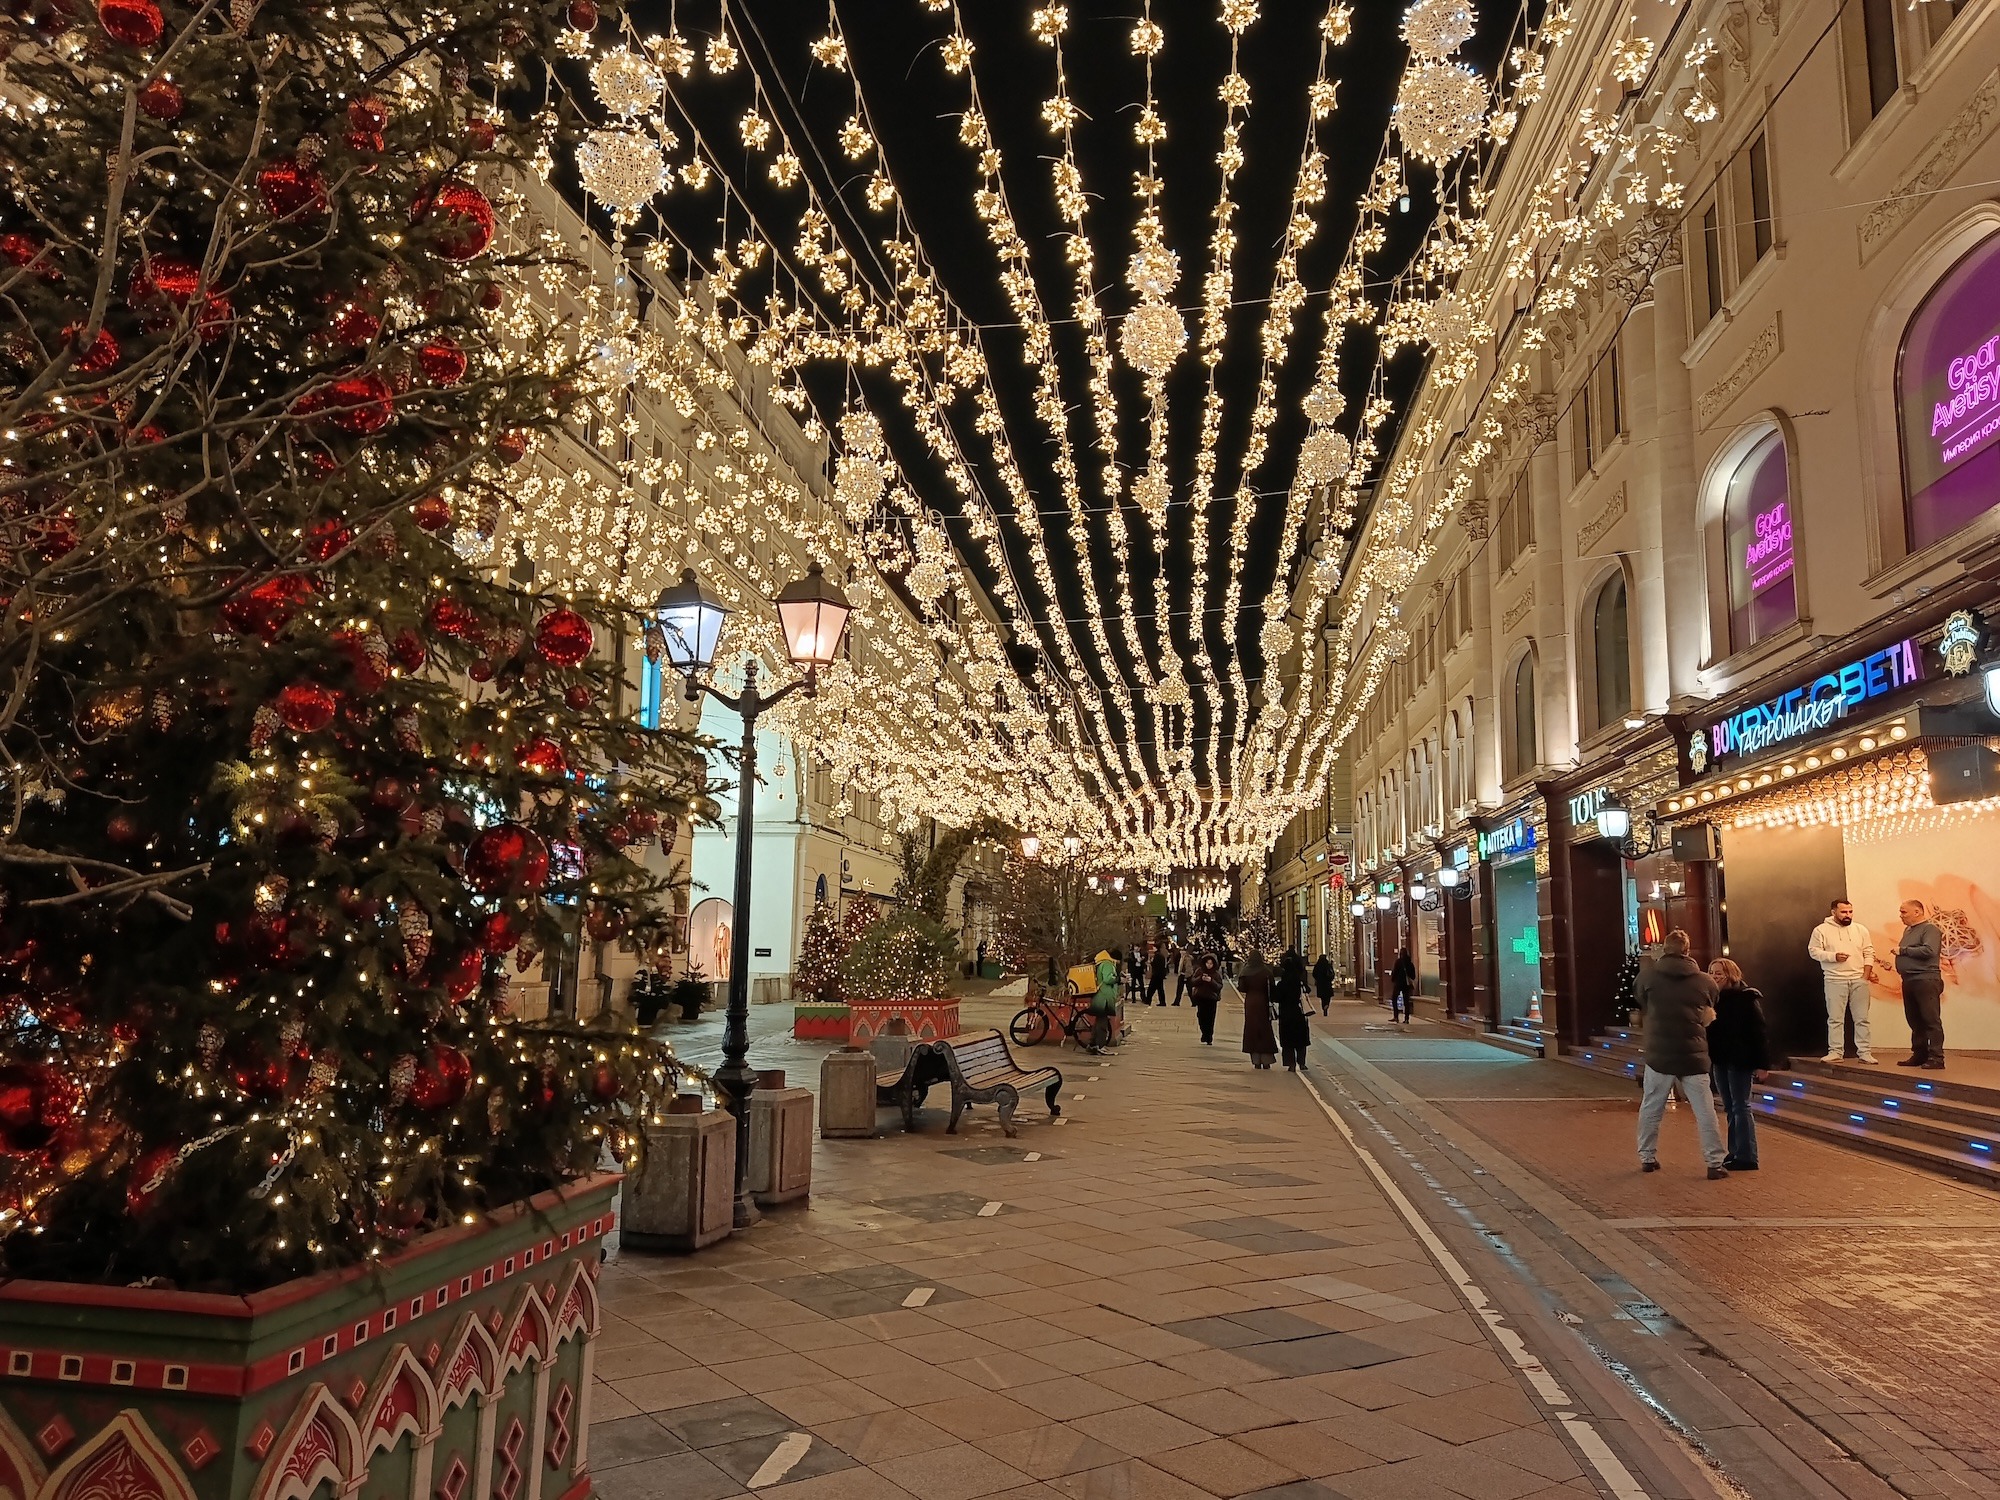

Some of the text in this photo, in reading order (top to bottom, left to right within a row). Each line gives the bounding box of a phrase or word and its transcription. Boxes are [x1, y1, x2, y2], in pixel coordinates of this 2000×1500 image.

[1948, 335, 1999, 390] Goar
[1943, 430, 1980, 463] Империя
[1756, 503, 1784, 537] Goar
[1809, 639, 1918, 706] СВЕТА
[1487, 825, 1515, 855] АПТЕКА
